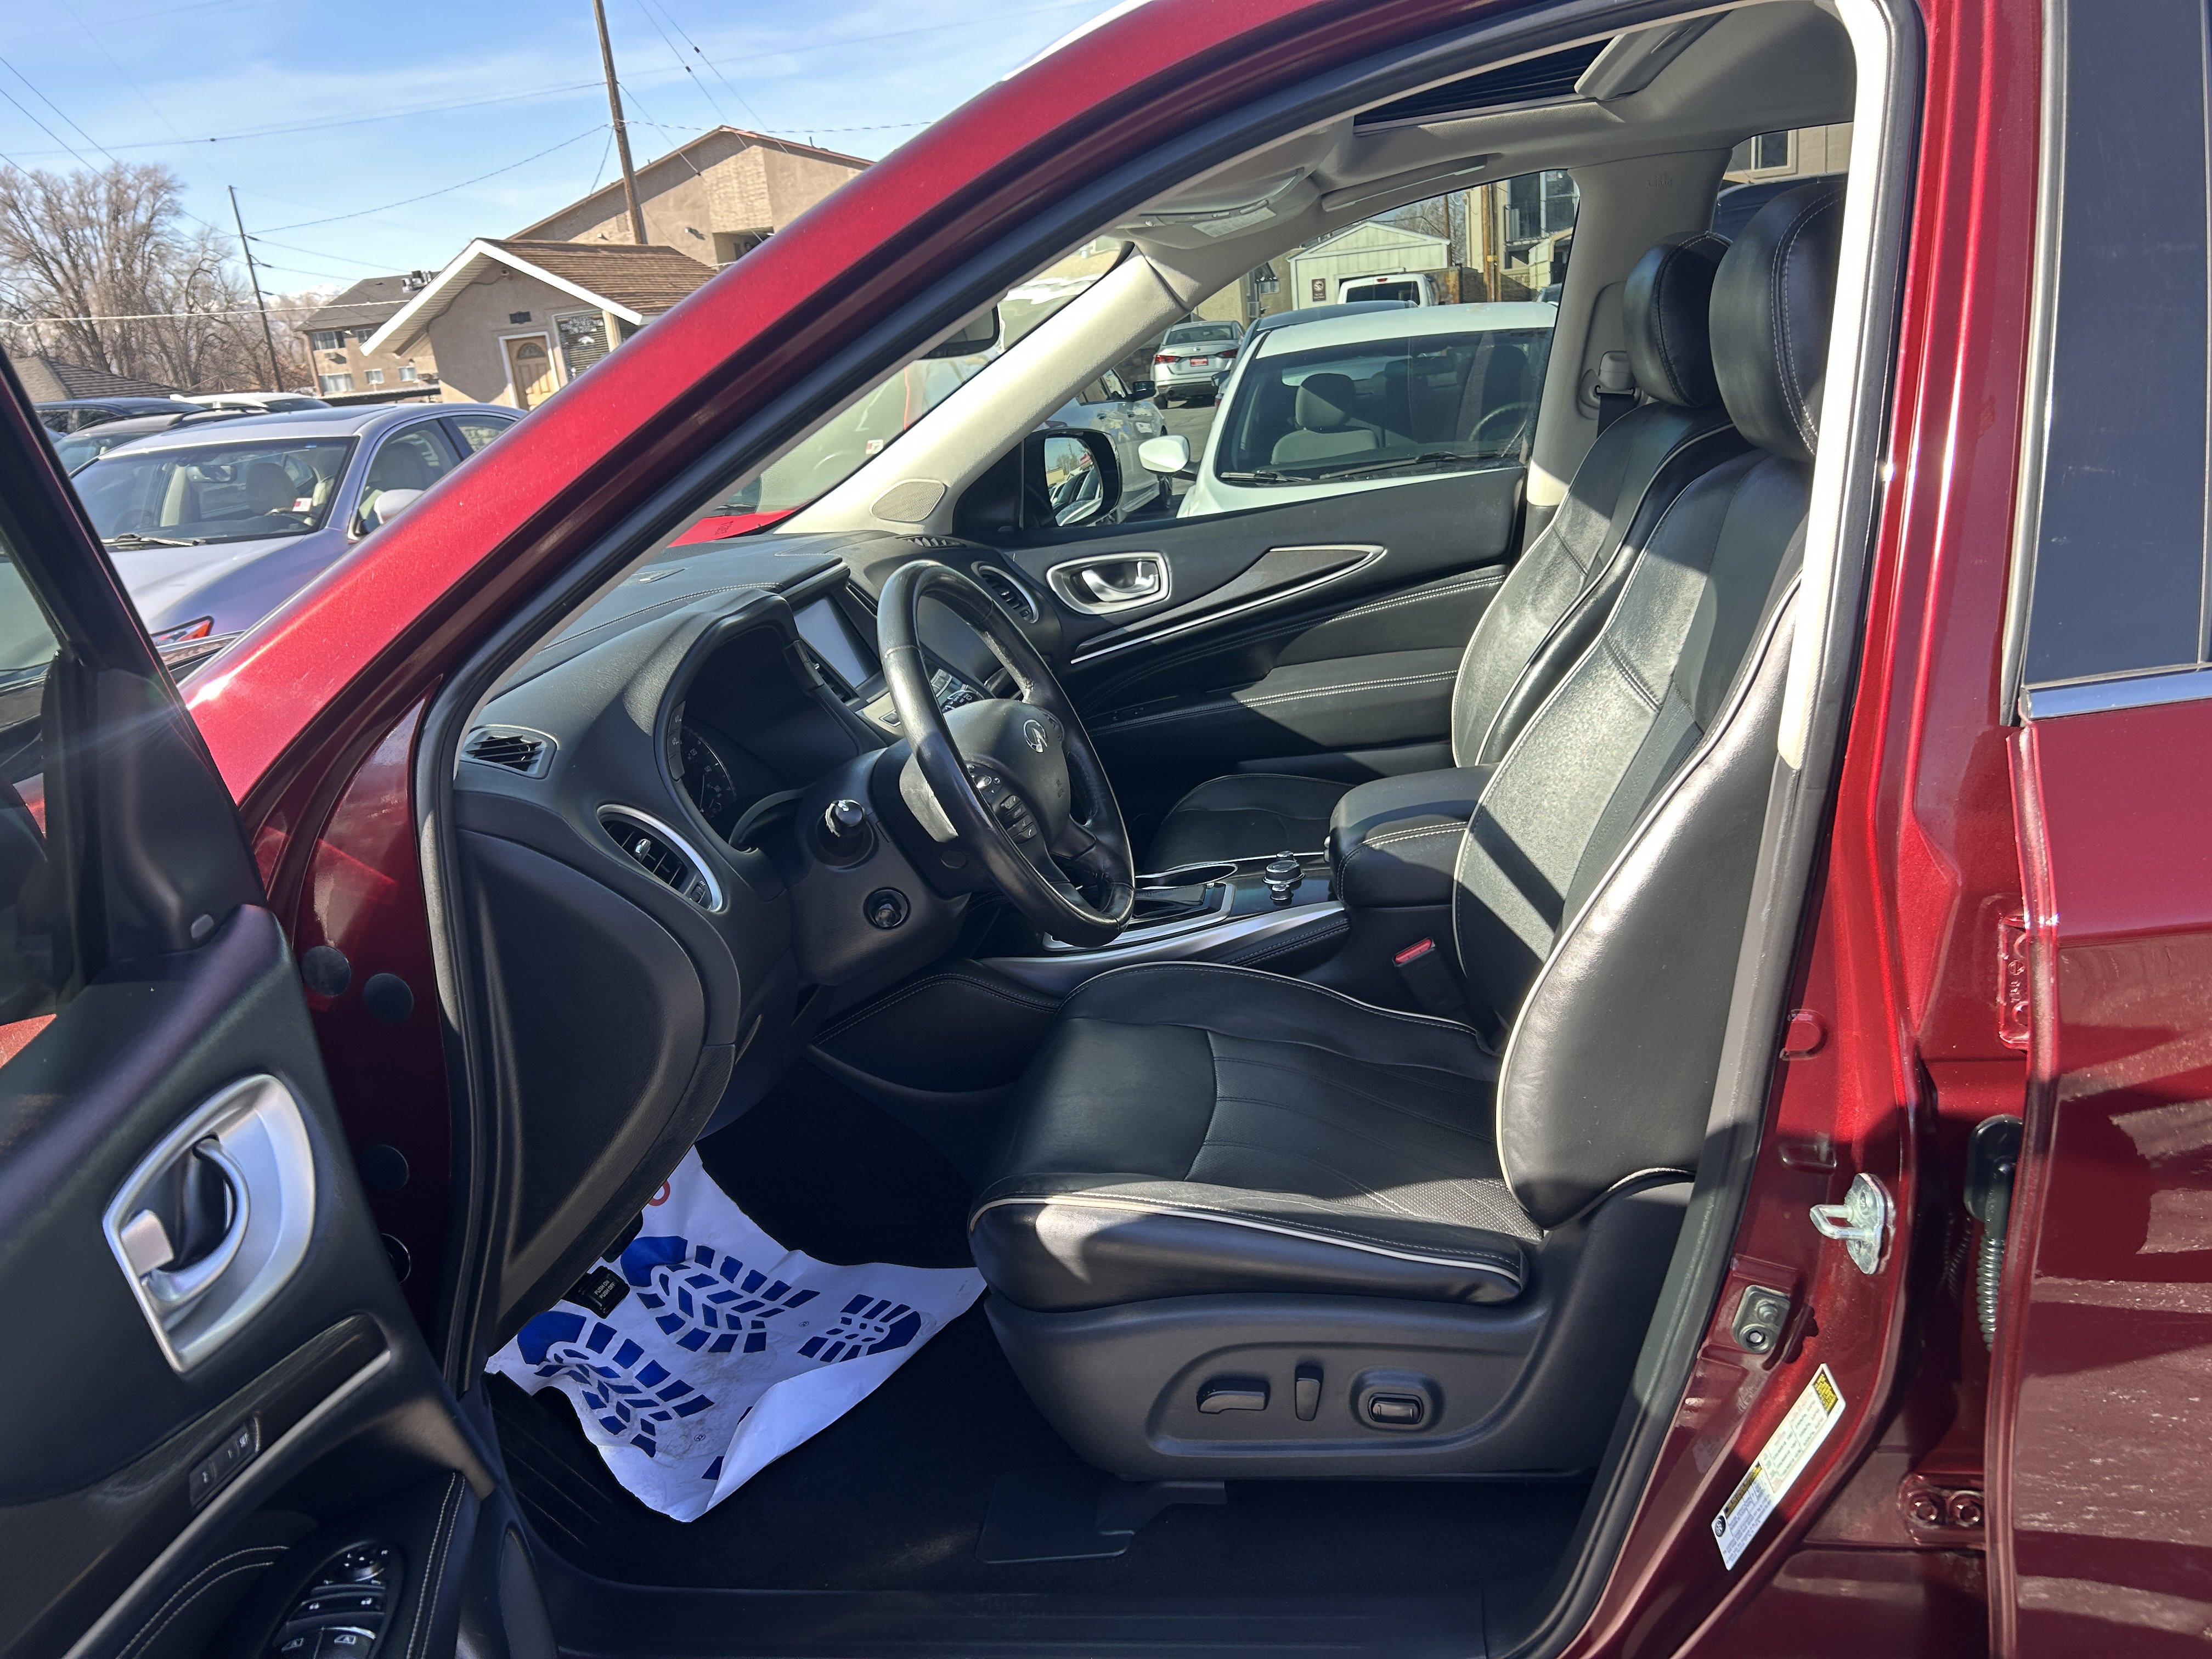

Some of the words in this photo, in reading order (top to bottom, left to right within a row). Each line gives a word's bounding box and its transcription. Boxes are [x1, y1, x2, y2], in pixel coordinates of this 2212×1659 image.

[594, 1284, 605, 1295] PUSH
[599, 1288, 611, 1299] PUSH
[607, 1281, 616, 1290] OFF
